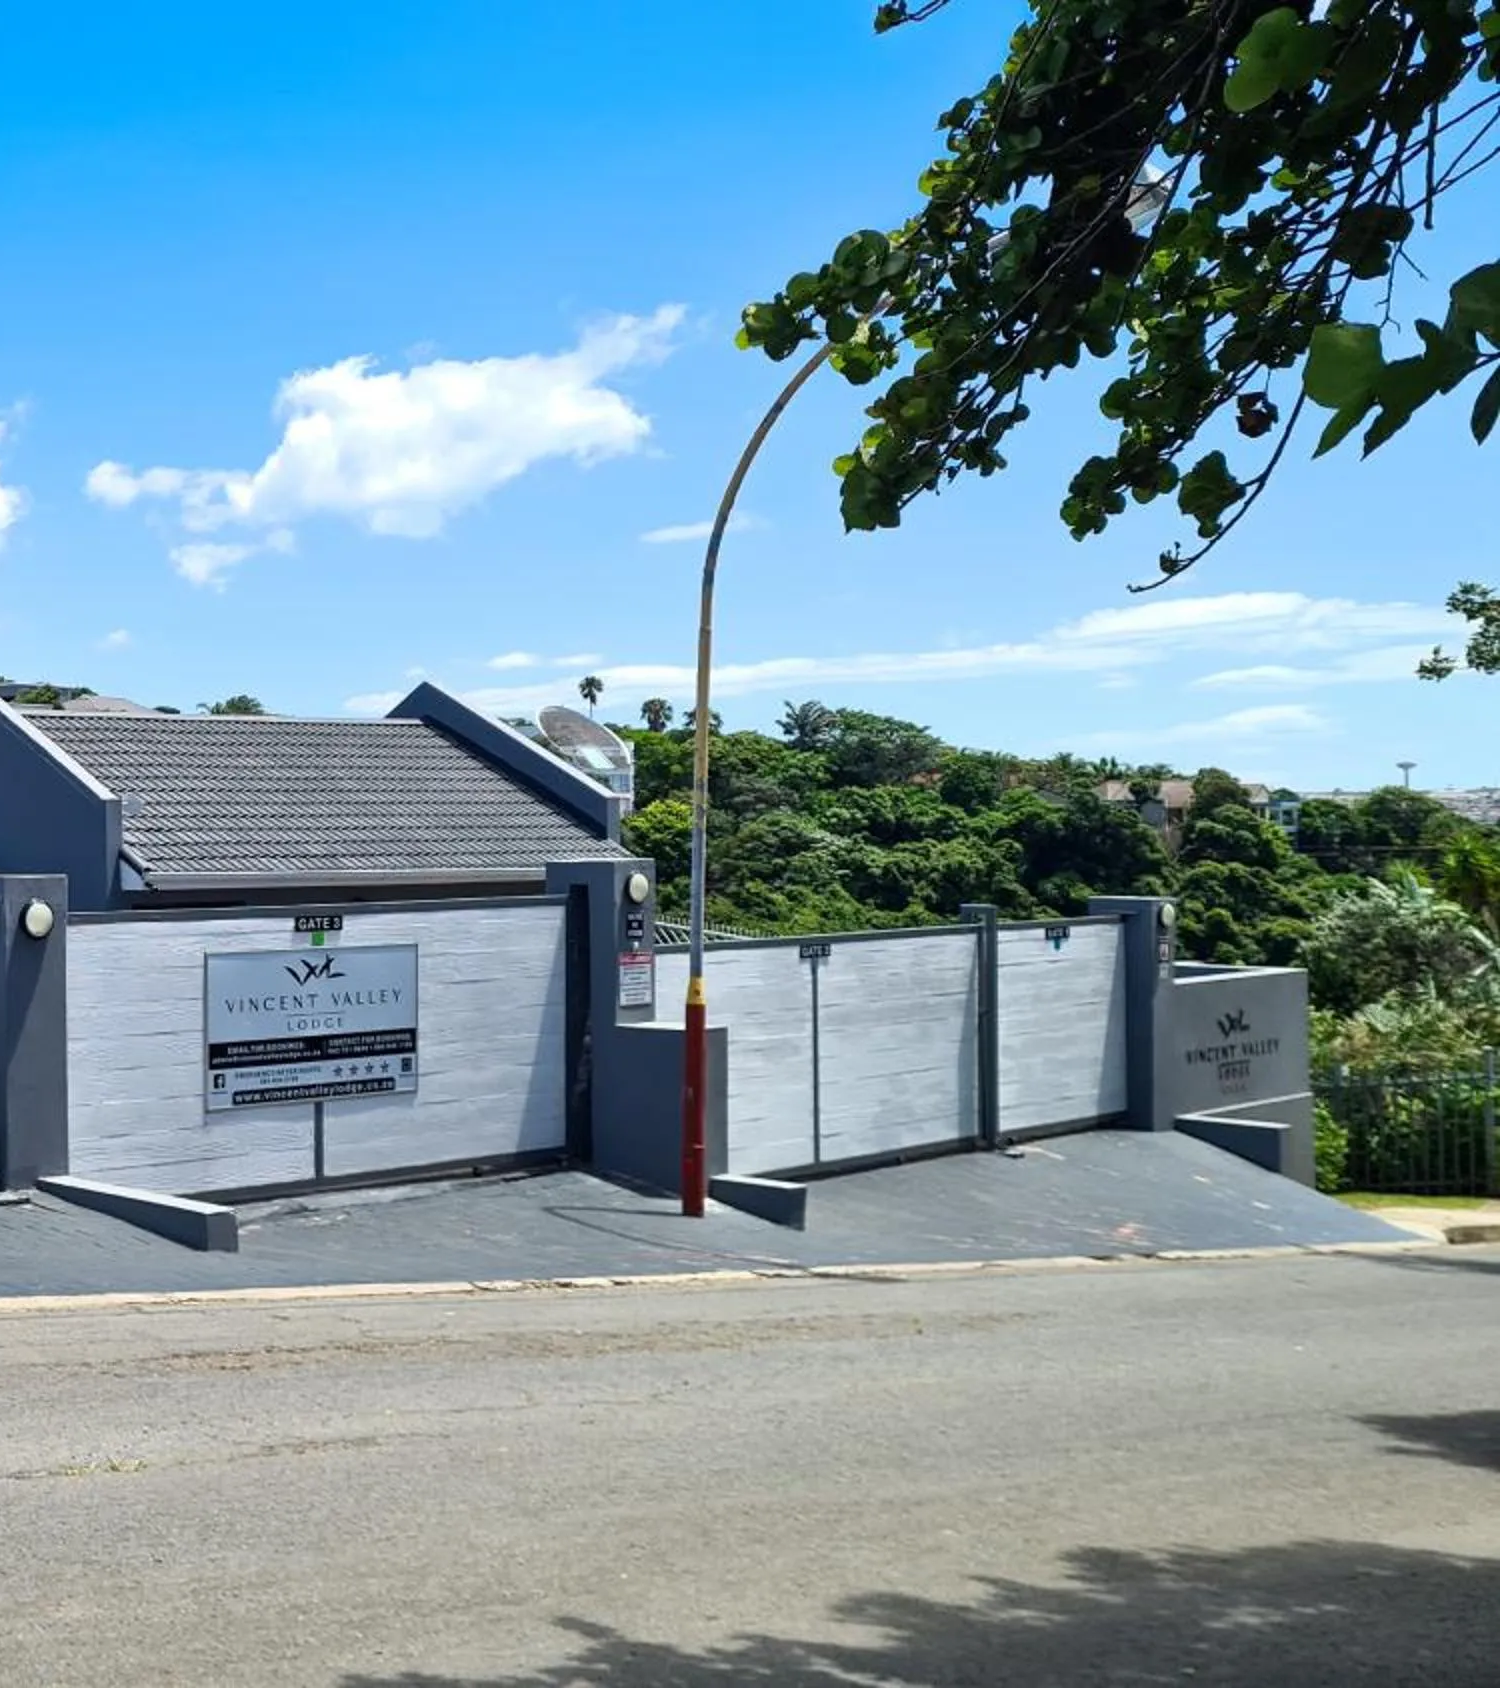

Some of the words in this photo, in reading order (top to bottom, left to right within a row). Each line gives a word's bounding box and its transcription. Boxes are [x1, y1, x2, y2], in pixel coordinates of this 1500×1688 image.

[297, 917, 331, 930] GATE
[332, 916, 341, 929] 3
[224, 993, 320, 1014] VINCENT
[330, 988, 402, 1007] VALLEY
[286, 1017, 344, 1033] LODGE
[1185, 1045, 1236, 1065] VINCENT
[1241, 1038, 1280, 1056] VALLEY
